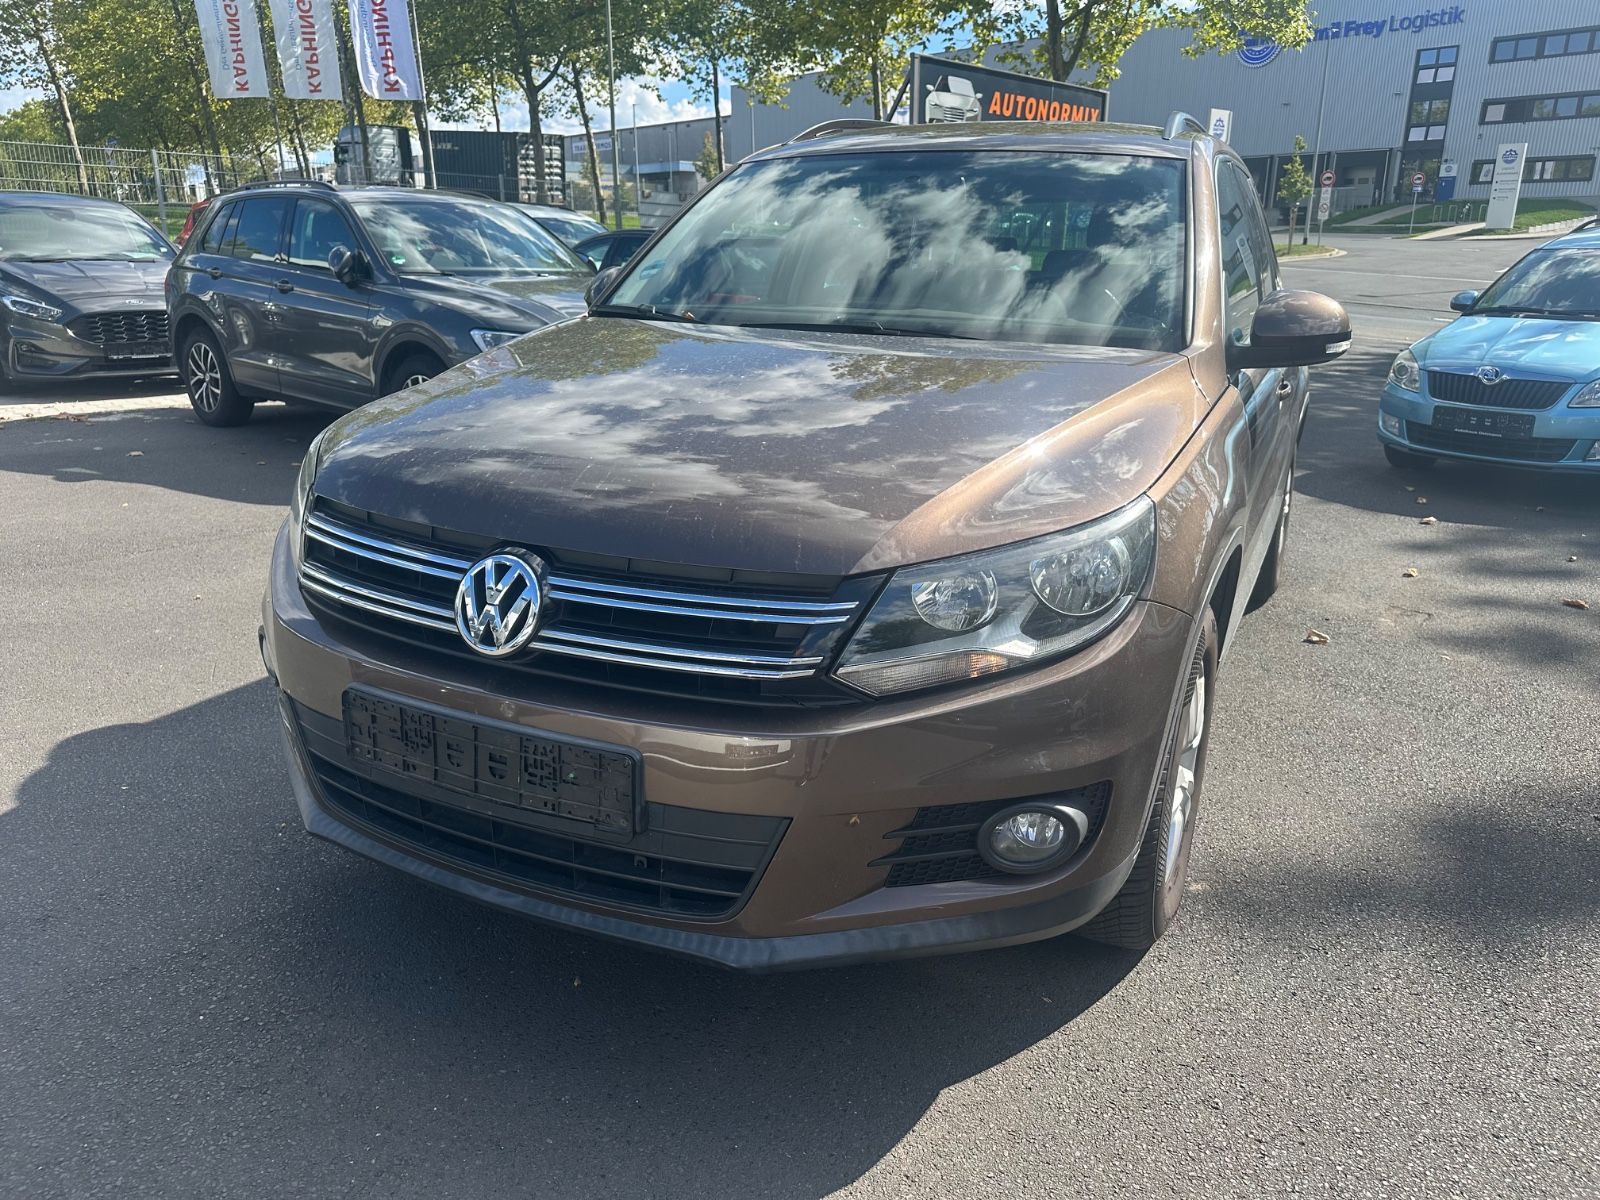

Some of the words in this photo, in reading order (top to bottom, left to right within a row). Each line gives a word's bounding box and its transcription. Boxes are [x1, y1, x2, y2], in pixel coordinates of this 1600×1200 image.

[1307, 21, 1343, 42] mil
[1343, 19, 1387, 39] Frey
[1388, 5, 1466, 34] Logistik
[988, 91, 1099, 122] AUTONORMIX
